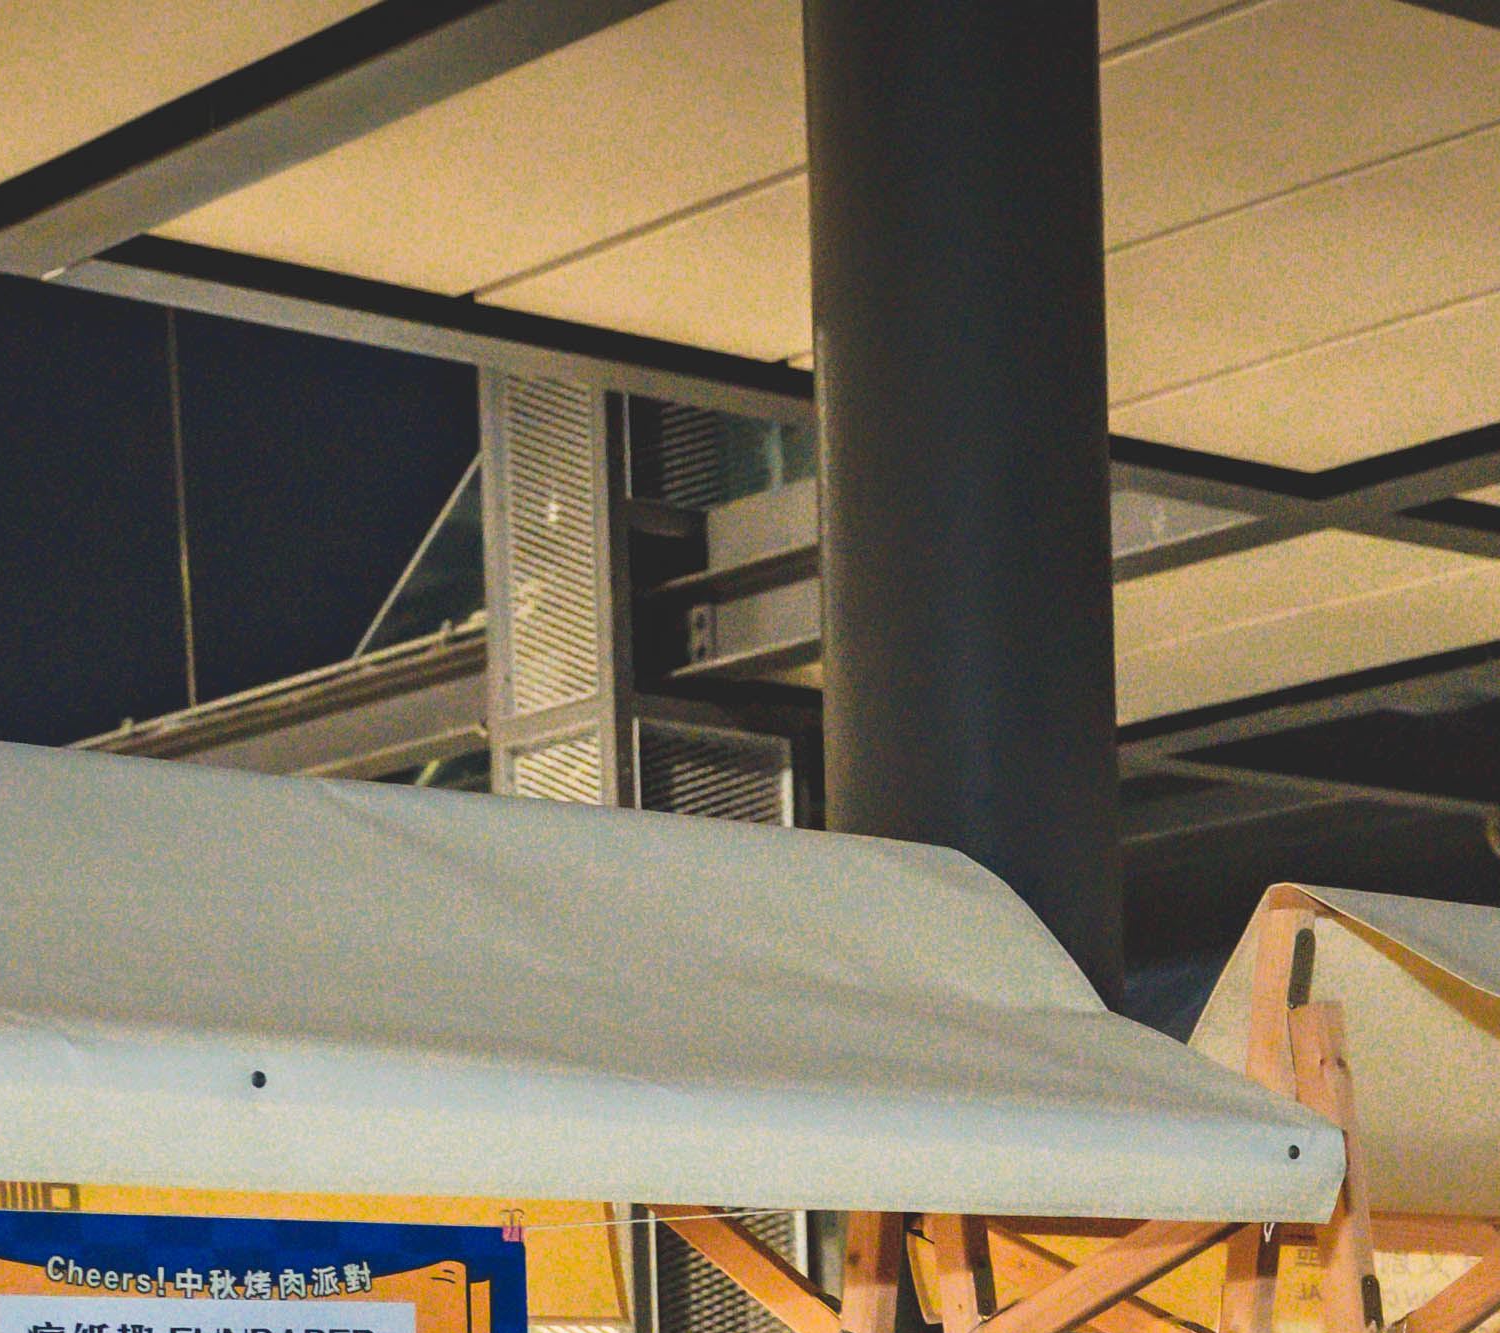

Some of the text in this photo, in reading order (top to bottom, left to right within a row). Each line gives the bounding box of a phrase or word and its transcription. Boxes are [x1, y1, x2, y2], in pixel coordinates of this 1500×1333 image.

[46, 1256, 373, 1300] Cheers! 中秋烤肉派對
